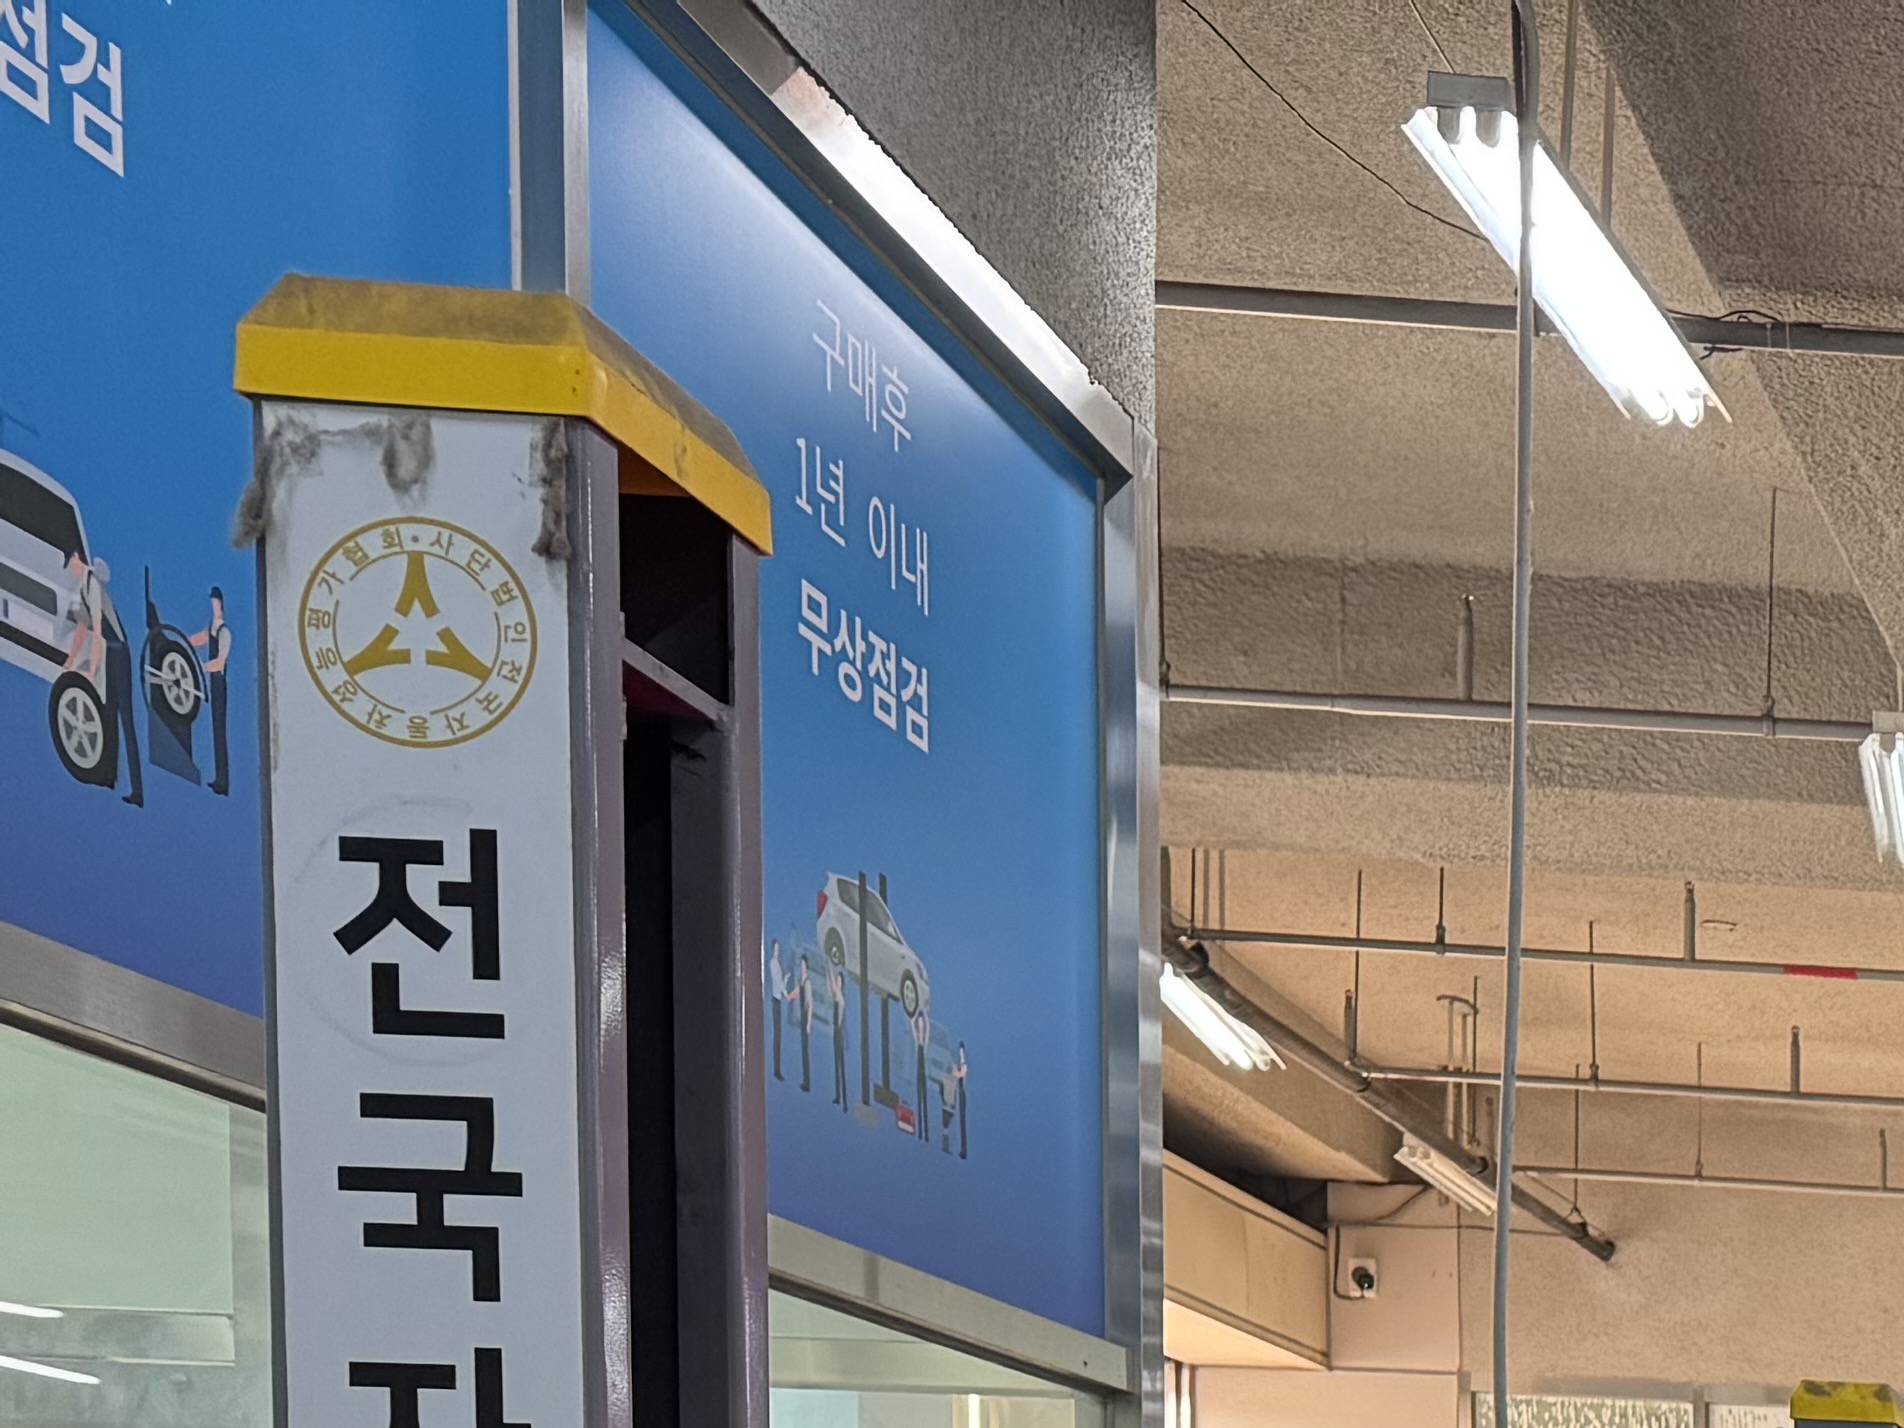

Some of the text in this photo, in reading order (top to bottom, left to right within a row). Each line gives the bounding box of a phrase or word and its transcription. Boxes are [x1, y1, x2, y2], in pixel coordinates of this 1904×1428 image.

[812, 299, 911, 452] 구매후
[796, 437, 929, 616] 1년 이내
[798, 578, 929, 754] 무상점검
